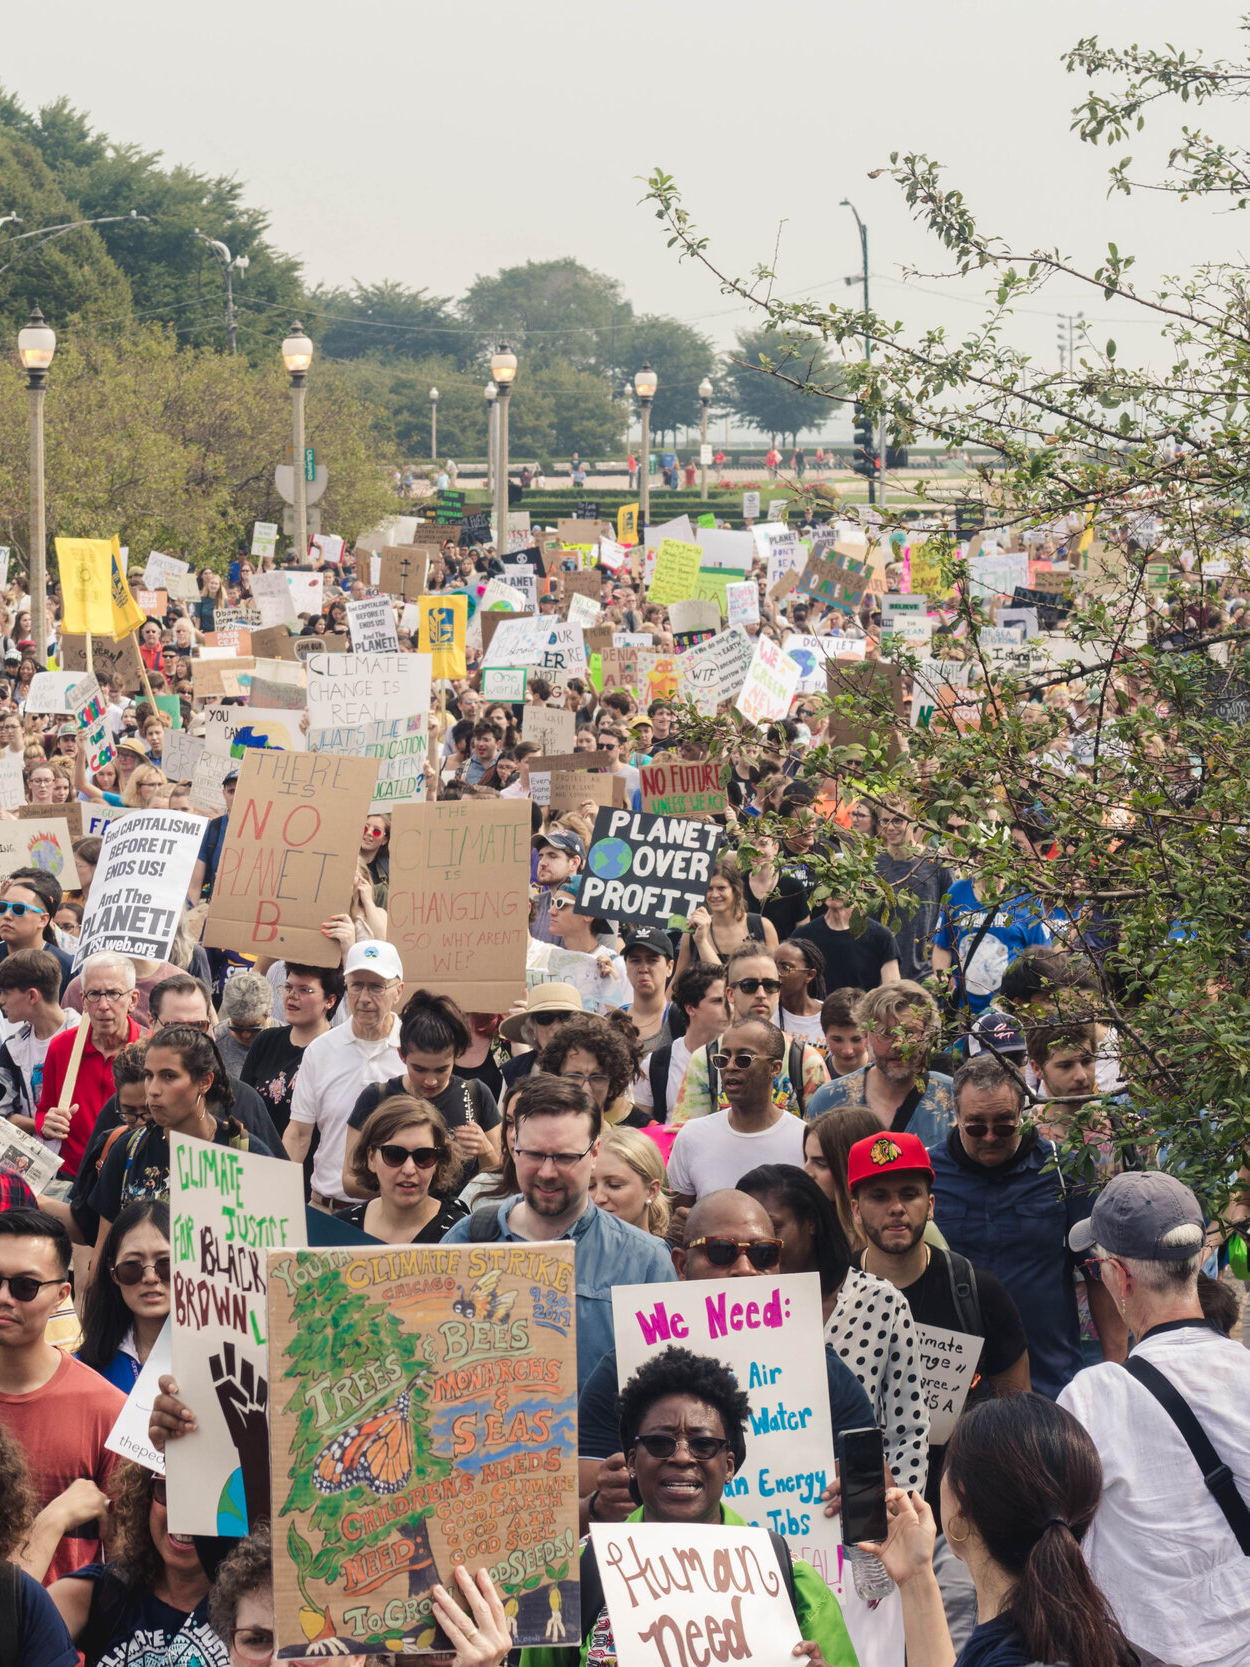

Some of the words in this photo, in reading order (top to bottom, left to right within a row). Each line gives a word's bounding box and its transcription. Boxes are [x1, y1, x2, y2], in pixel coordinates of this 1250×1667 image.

[769, 532, 797, 545] PLANET
[812, 529, 840, 539] PLANET
[356, 611, 377, 620] BEFORE
[359, 621, 375, 629] ENDS
[376, 619, 386, 627] US!
[354, 637, 397, 653] PLANET!
[721, 641, 742, 655] EARTH
[759, 640, 779, 670] WE
[835, 639, 857, 651] LET
[308, 654, 409, 677] CLIMATE
[493, 672, 518, 683] One
[692, 668, 717, 682] WTF
[719, 670, 740, 682] borrow
[308, 680, 373, 702] CHANGE
[383, 680, 400, 695] IS
[486, 684, 521, 696] world
[208, 710, 229, 723] YOU
[373, 718, 404, 740] THE
[251, 752, 353, 792] THERE
[642, 767, 666, 797] NO
[278, 781, 317, 798] IS
[532, 785, 550, 794] Sane
[435, 806, 468, 819] THE
[651, 795, 687, 815] UNLESS
[689, 795, 706, 810] WE
[121, 817, 200, 837] CAPITALISM!
[236, 798, 322, 847] NO
[608, 810, 724, 852] PLANET
[108, 837, 158, 862] BEFORE
[159, 838, 178, 856] IT
[393, 822, 529, 871] CLIMATE
[105, 859, 137, 883] ENDS
[138, 860, 166, 878] US!
[216, 847, 339, 904] PLANET
[444, 869, 462, 881] IS
[632, 846, 711, 883] OVER
[100, 890, 124, 907] And
[125, 888, 152, 905] The
[389, 890, 520, 928] CHANGING
[581, 877, 705, 920] PROFIT
[81, 904, 176, 945] PLANET!
[402, 932, 432, 952] SO
[442, 931, 472, 949] WHY
[475, 929, 525, 946] AREN'T
[433, 951, 475, 973] WE?
[175, 1145, 244, 1210] CLIMATE
[173, 1213, 196, 1264] FOR
[200, 1225, 267, 1296] BLACK
[271, 1247, 355, 1299] YOUTH
[344, 1250, 461, 1290] CLIMATE
[467, 1248, 575, 1293] STRIKE
[381, 1277, 456, 1301] CHICAGO
[173, 1270, 248, 1335] BROWN
[532, 1304, 572, 1327] 2019
[634, 1301, 690, 1346] We
[704, 1288, 792, 1340] Need:
[438, 1318, 531, 1363] BEES
[431, 1358, 563, 1403] MONARCHS
[748, 1361, 783, 1390] Air
[302, 1352, 403, 1430] TREES
[748, 1402, 814, 1437] Water
[450, 1408, 554, 1459] SEAS
[340, 1466, 476, 1542] CHILDREN'S
[481, 1447, 563, 1486] NEEDS
[757, 1468, 827, 1505] Energy
[488, 1490, 564, 1520] EARTH
[507, 1509, 557, 1532] AIR
[767, 1508, 812, 1537] Jobs
[505, 1526, 557, 1551] SOIL
[606, 1536, 781, 1609] Human
[638, 1595, 754, 1667] need
